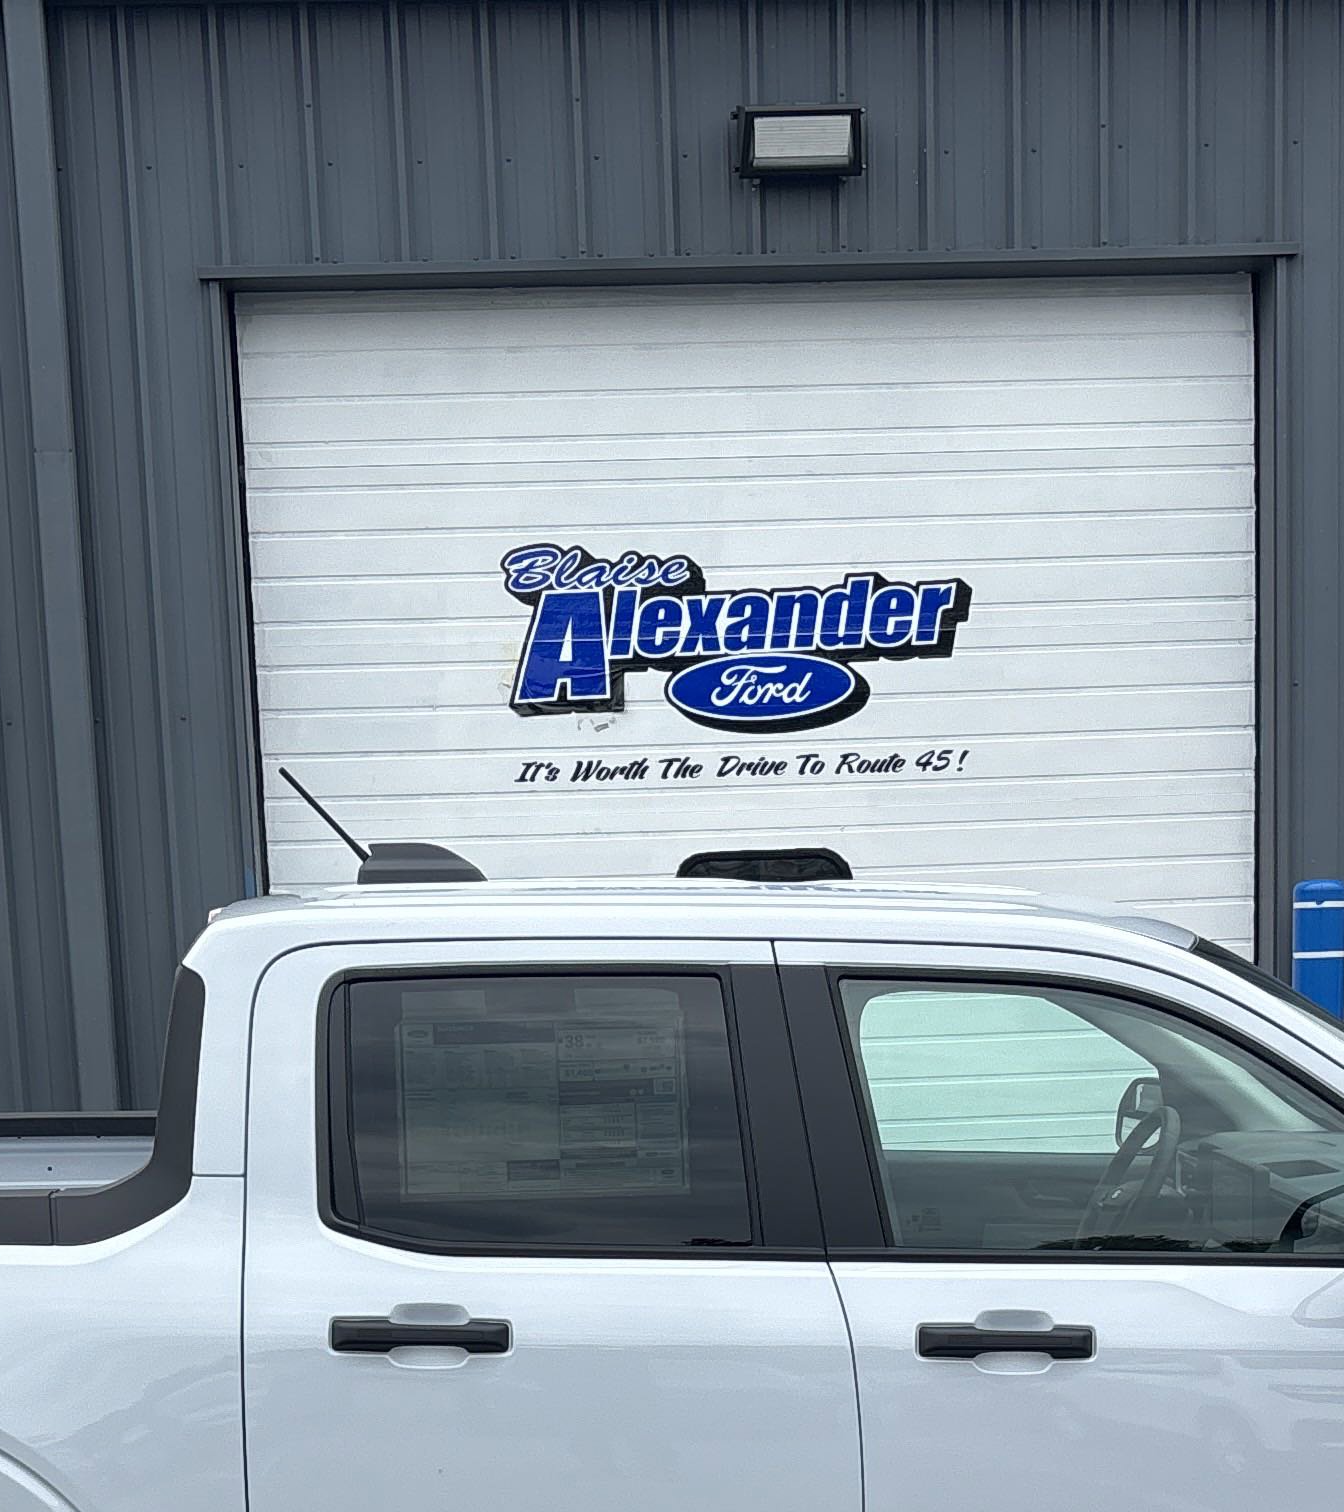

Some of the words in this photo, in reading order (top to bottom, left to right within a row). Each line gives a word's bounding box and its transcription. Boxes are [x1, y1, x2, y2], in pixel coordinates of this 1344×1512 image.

[503, 546, 690, 592] Blaise
[513, 576, 958, 704] Alexander
[710, 666, 812, 708] Ford
[514, 761, 561, 783] It's
[570, 757, 649, 782] Worth
[659, 756, 703, 779] The
[716, 755, 788, 777] Drive
[796, 753, 825, 775] To
[835, 752, 906, 775] Route
